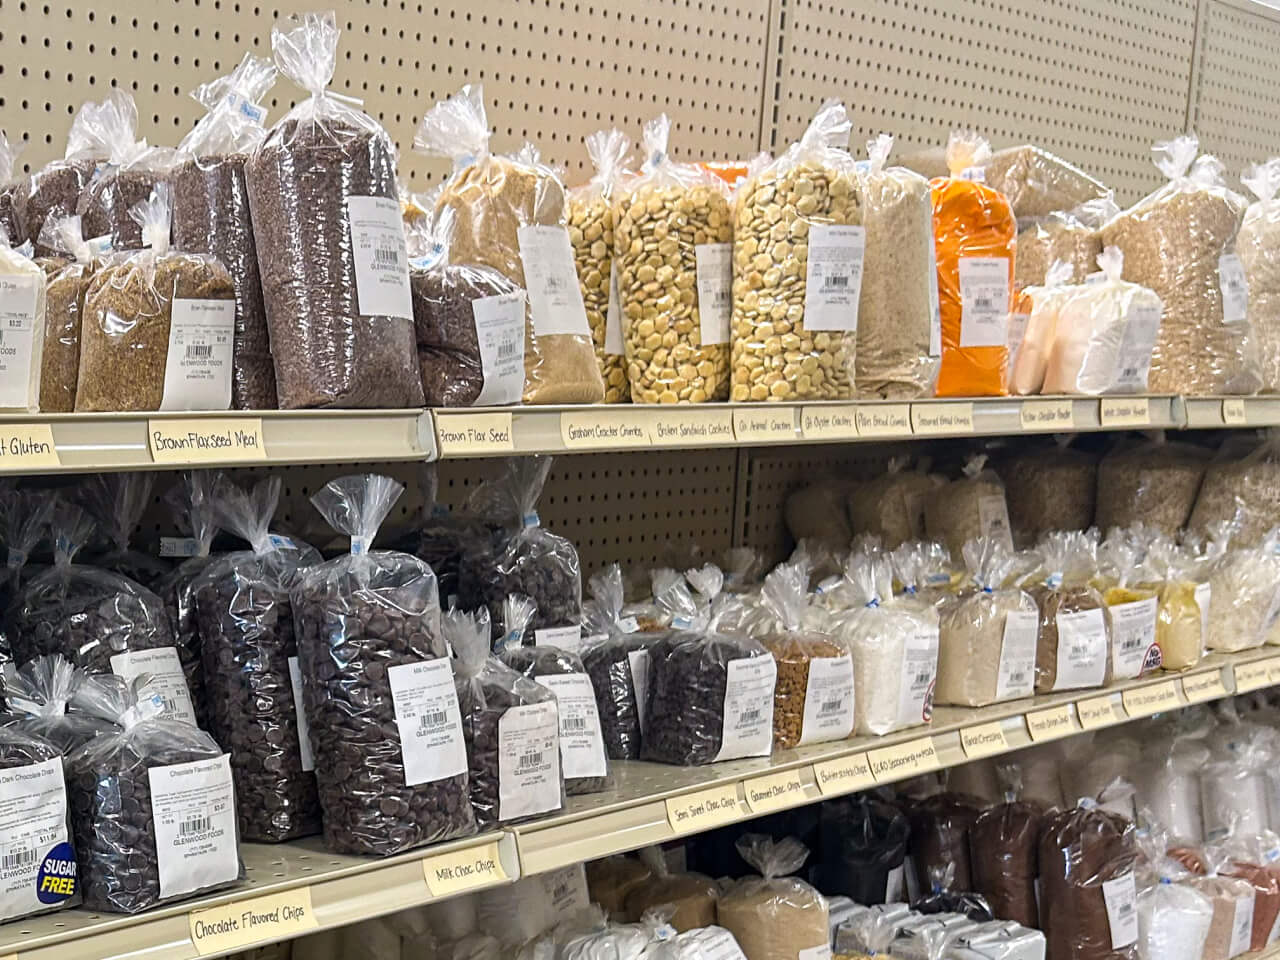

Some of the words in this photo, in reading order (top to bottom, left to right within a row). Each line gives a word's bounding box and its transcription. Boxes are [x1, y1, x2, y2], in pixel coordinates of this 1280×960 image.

[235, 430, 258, 449] Meal
[467, 428, 486, 442] Flax
[489, 428, 509, 442] Seed
[10, 436, 51, 456] Gluten
[173, 834, 207, 846] GLENWOOD
[43, 858, 76, 877] SUGAR
[434, 865, 454, 881] Milk
[475, 857, 496, 876] Chips
[40, 876, 75, 895] FREE
[194, 915, 239, 940] Chocolate
[241, 908, 281, 930] Flavored
[282, 903, 305, 923] Chips
